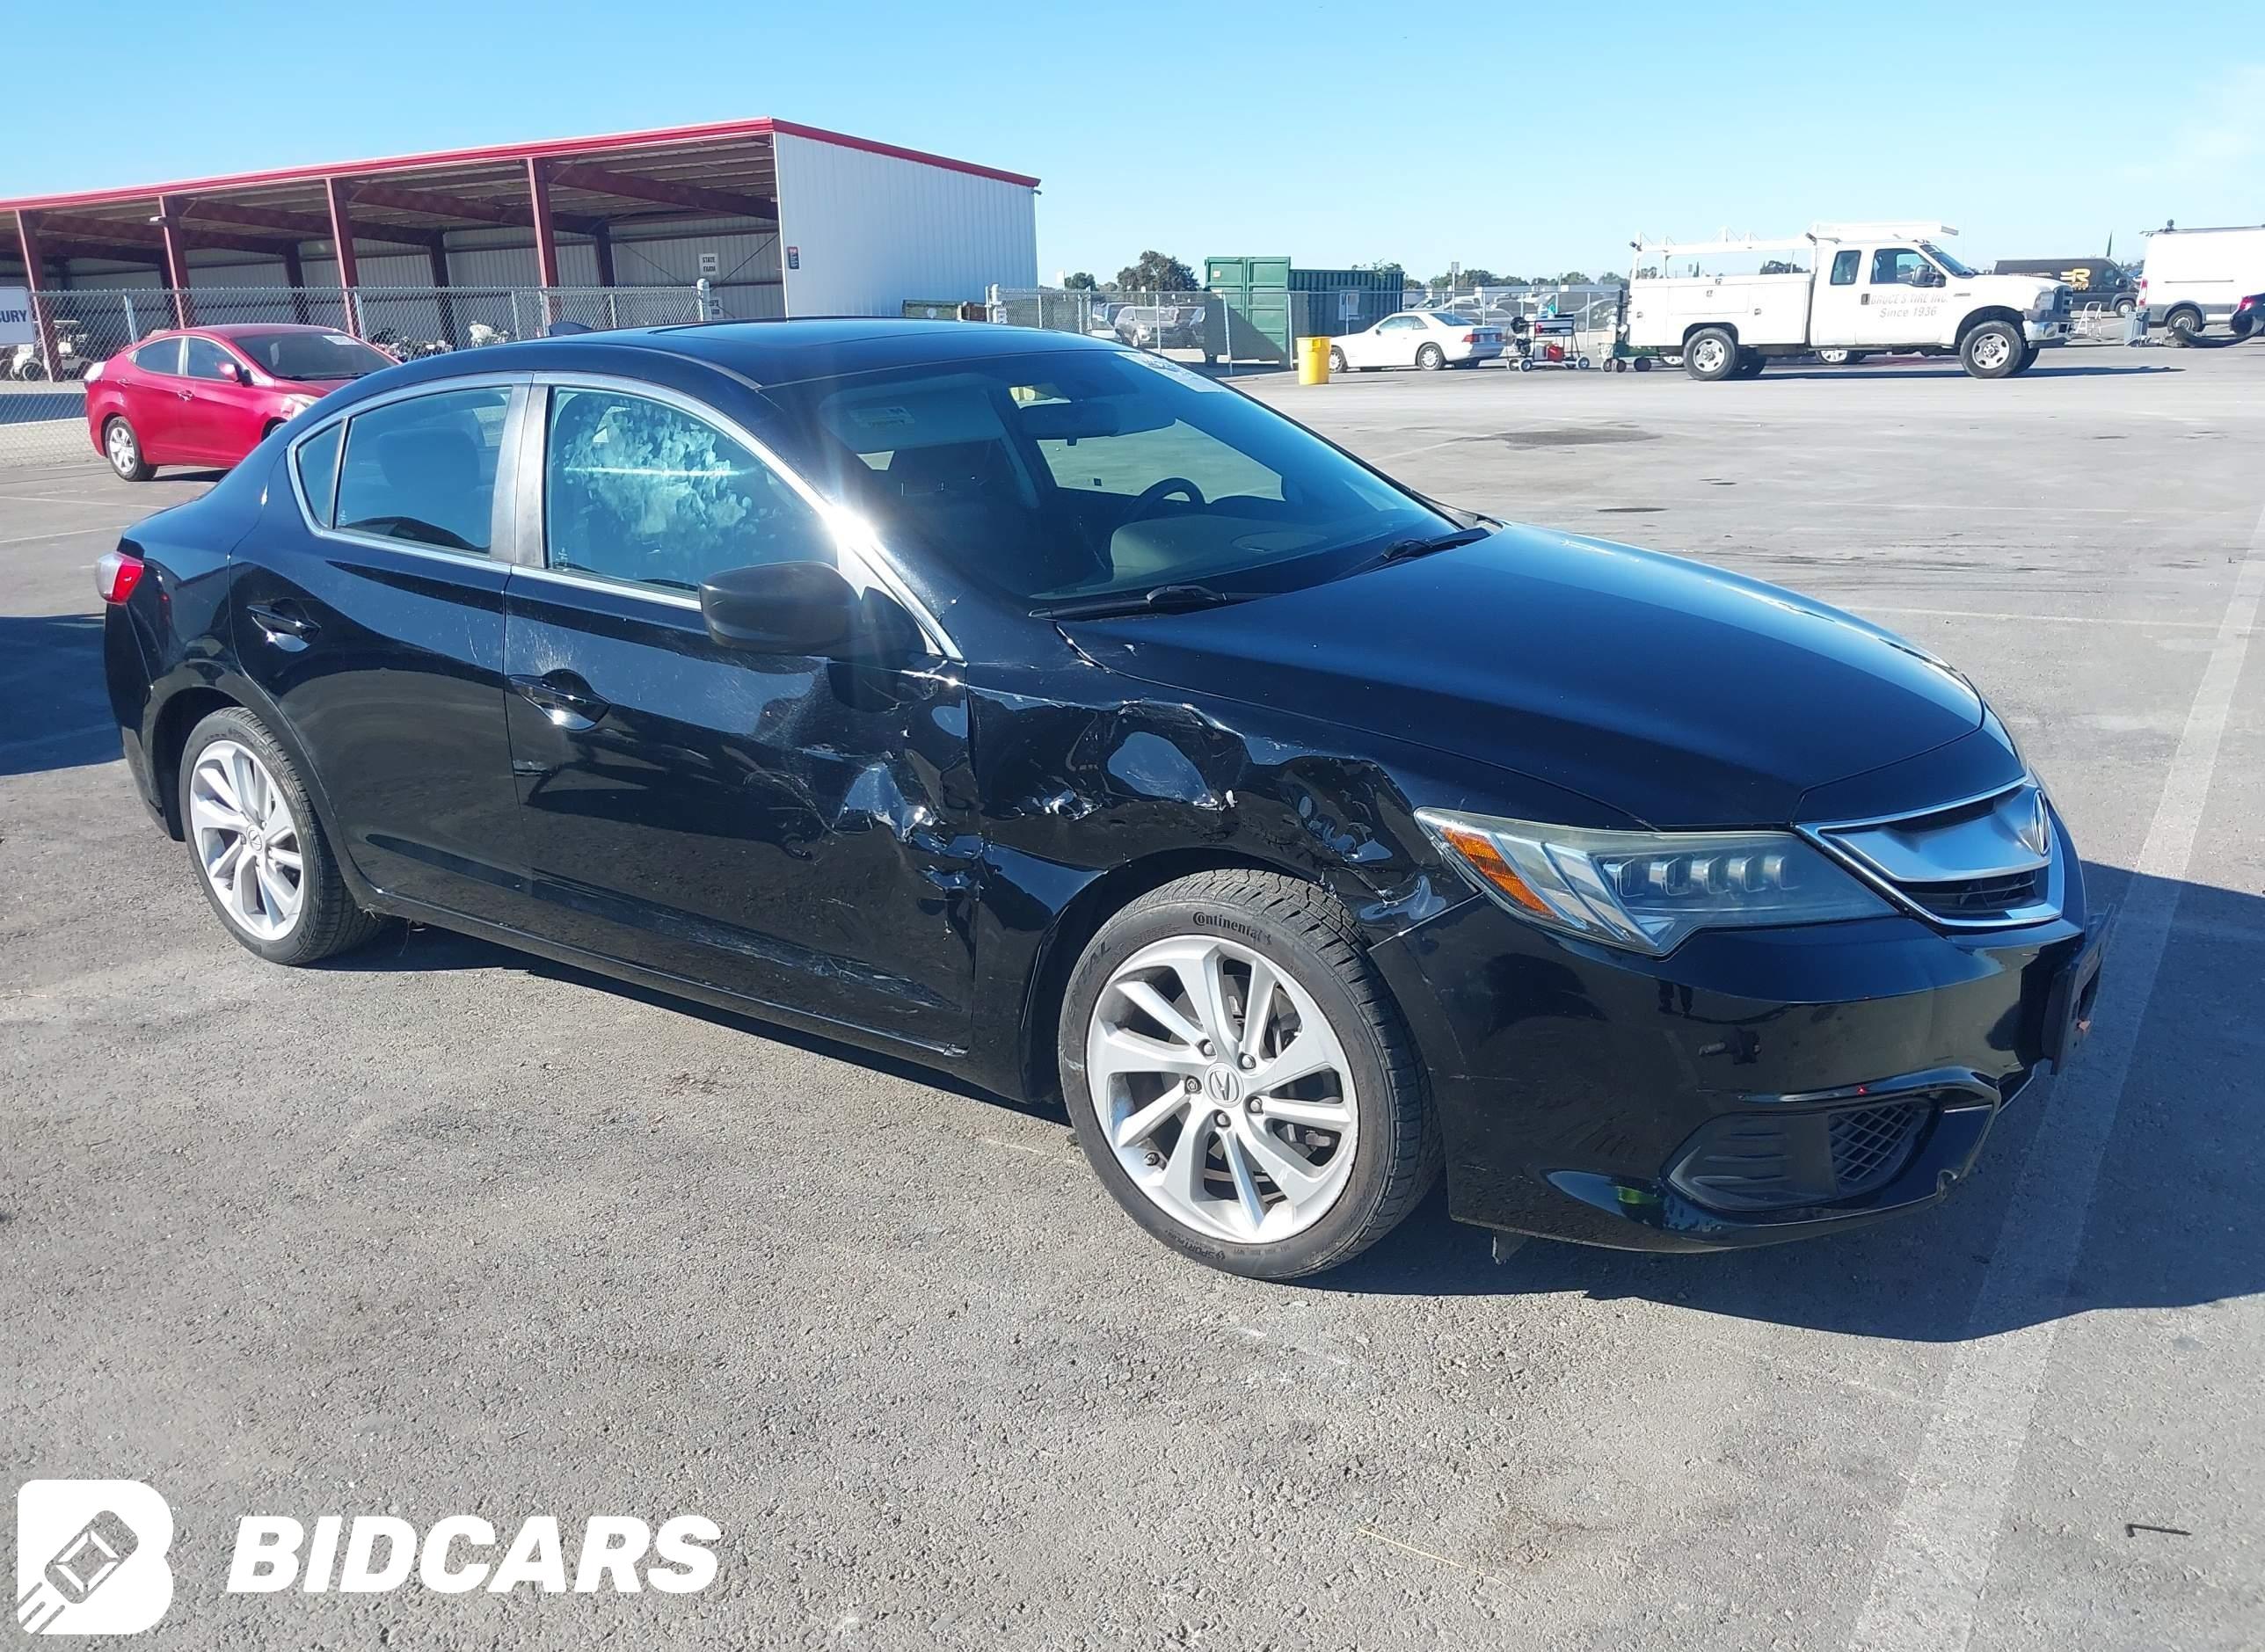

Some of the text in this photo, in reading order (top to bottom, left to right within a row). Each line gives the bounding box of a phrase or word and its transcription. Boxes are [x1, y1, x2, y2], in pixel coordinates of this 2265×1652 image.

[1870, 294, 1906, 305] BRUCES
[0, 309, 27, 323] URY
[1879, 306, 1938, 318] Since 1936
[1192, 911, 1263, 942] Continental
